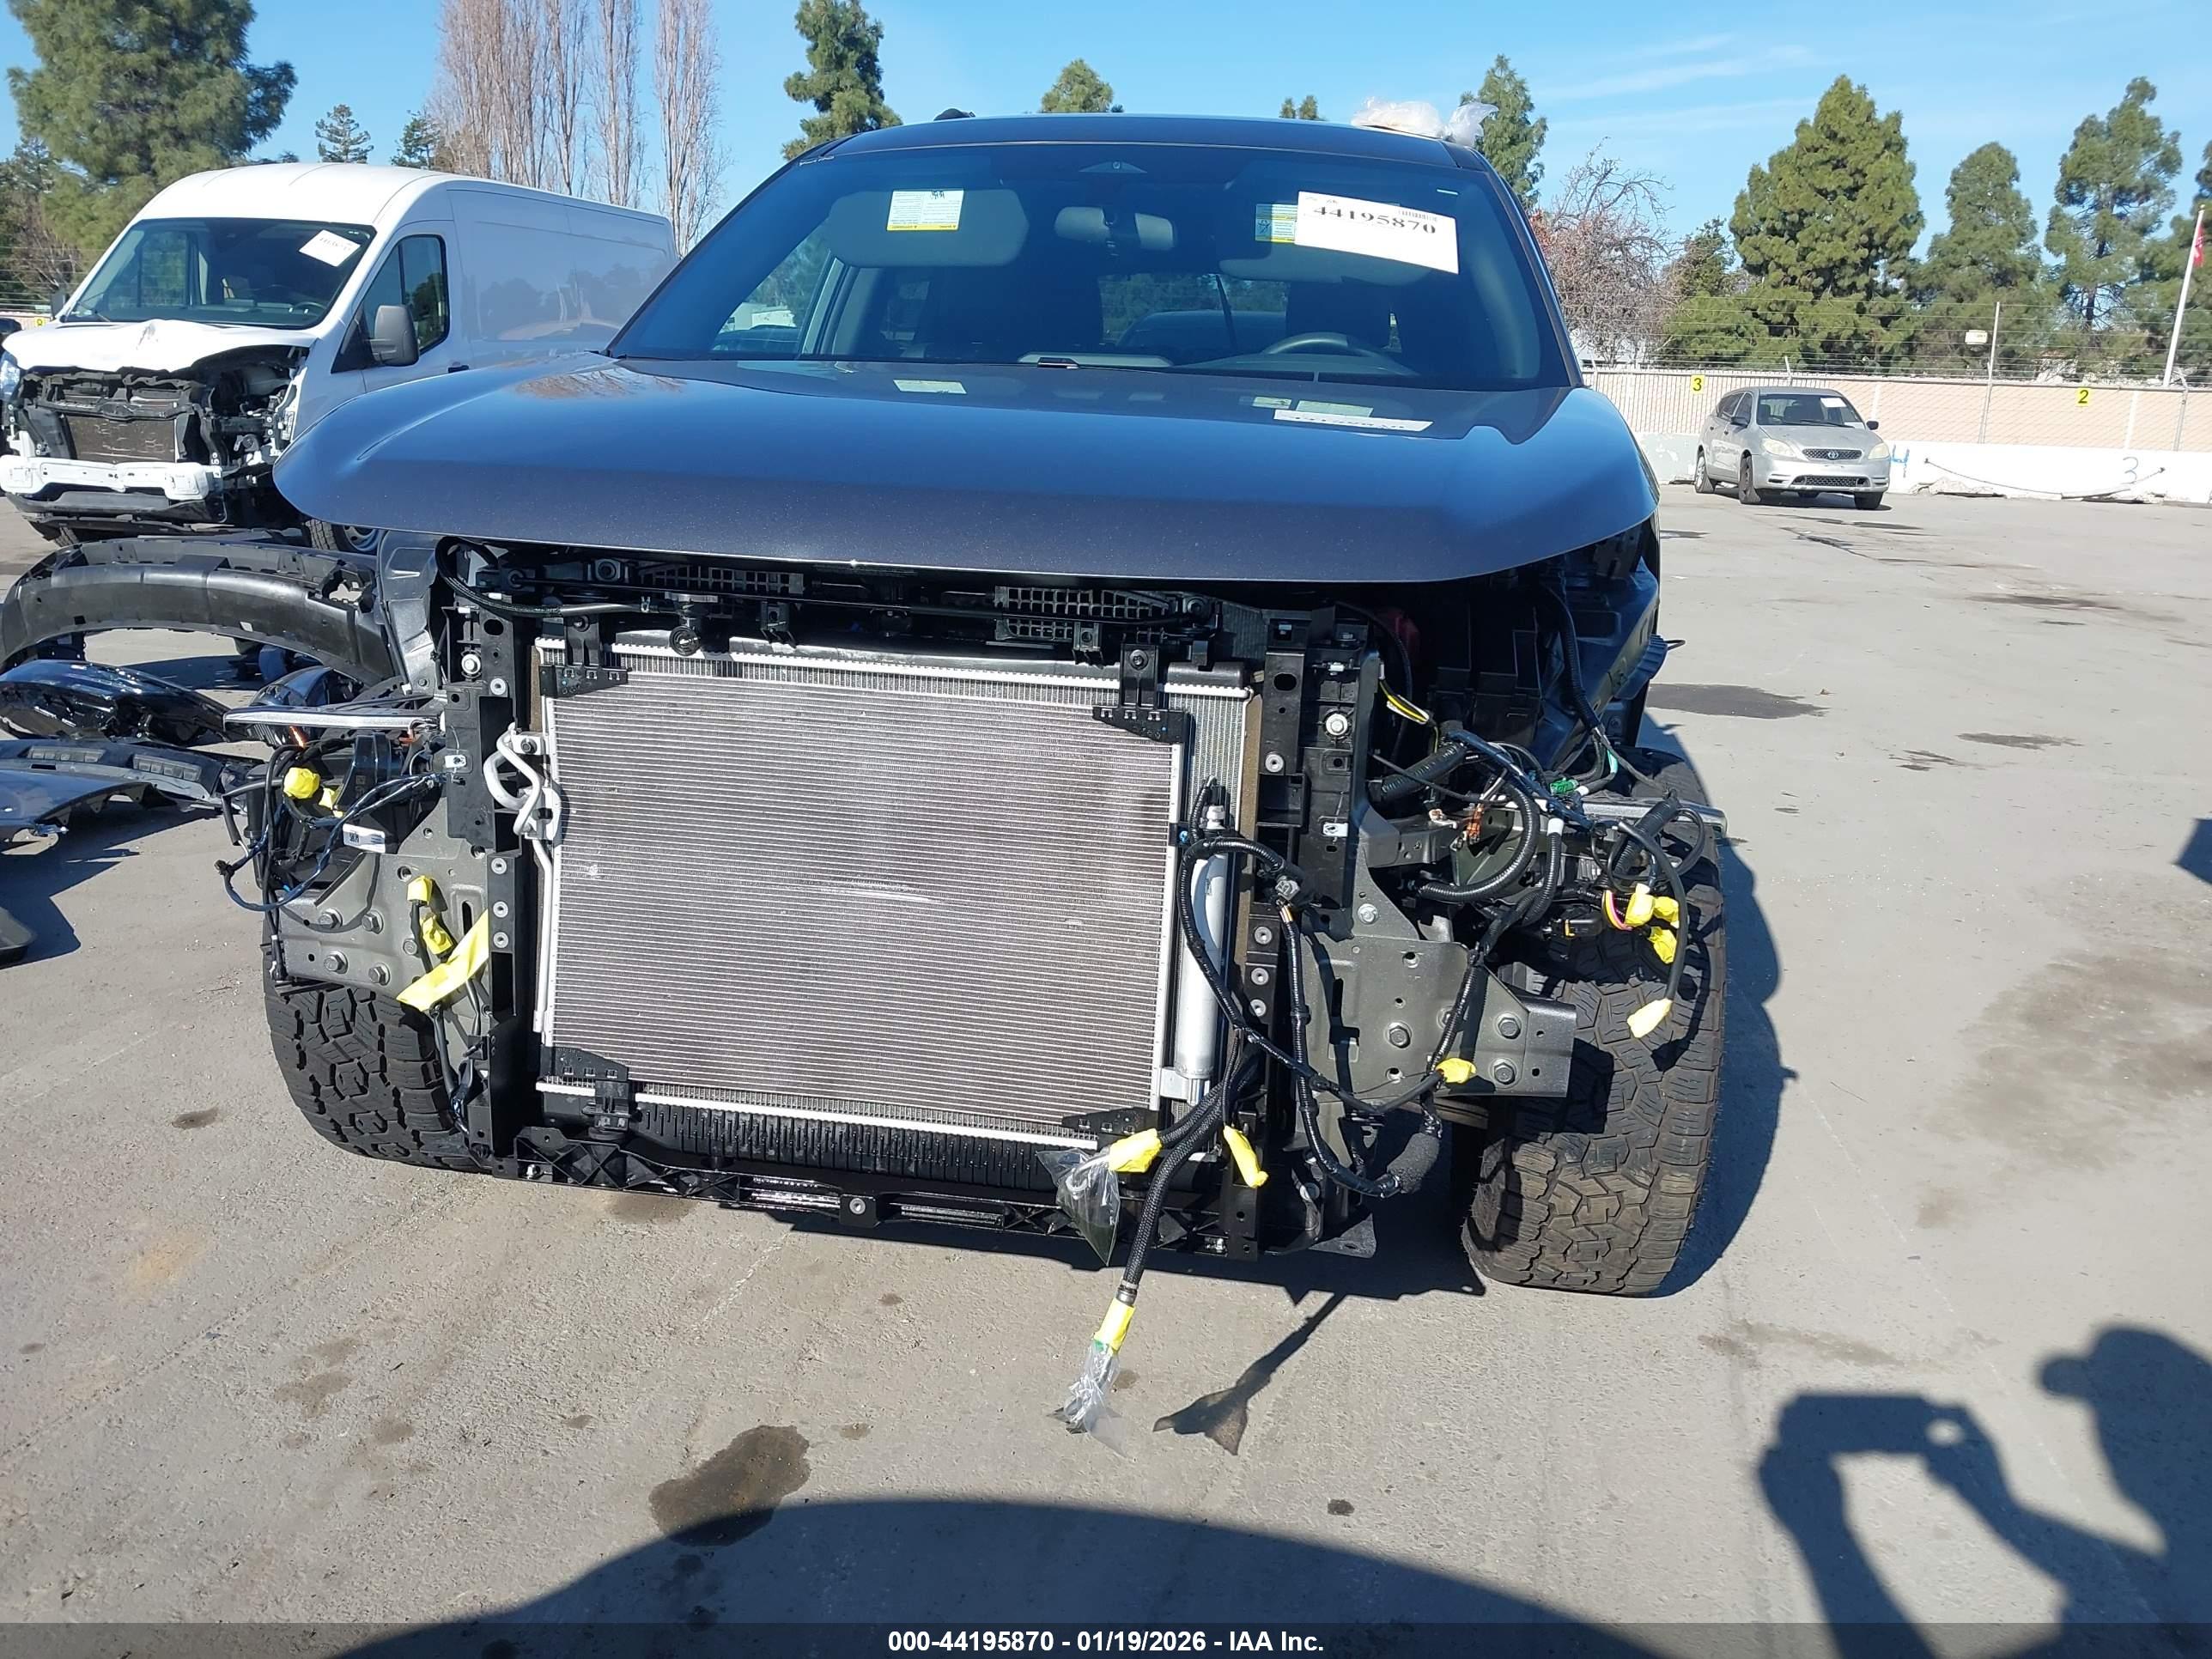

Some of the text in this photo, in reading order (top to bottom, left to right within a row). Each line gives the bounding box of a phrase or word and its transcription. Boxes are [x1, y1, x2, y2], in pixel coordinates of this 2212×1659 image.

[1313, 205, 1437, 234] 44195870
[1692, 377, 1702, 392] 3
[2078, 389, 2089, 404] 2
[2121, 456, 2139, 484] 3
